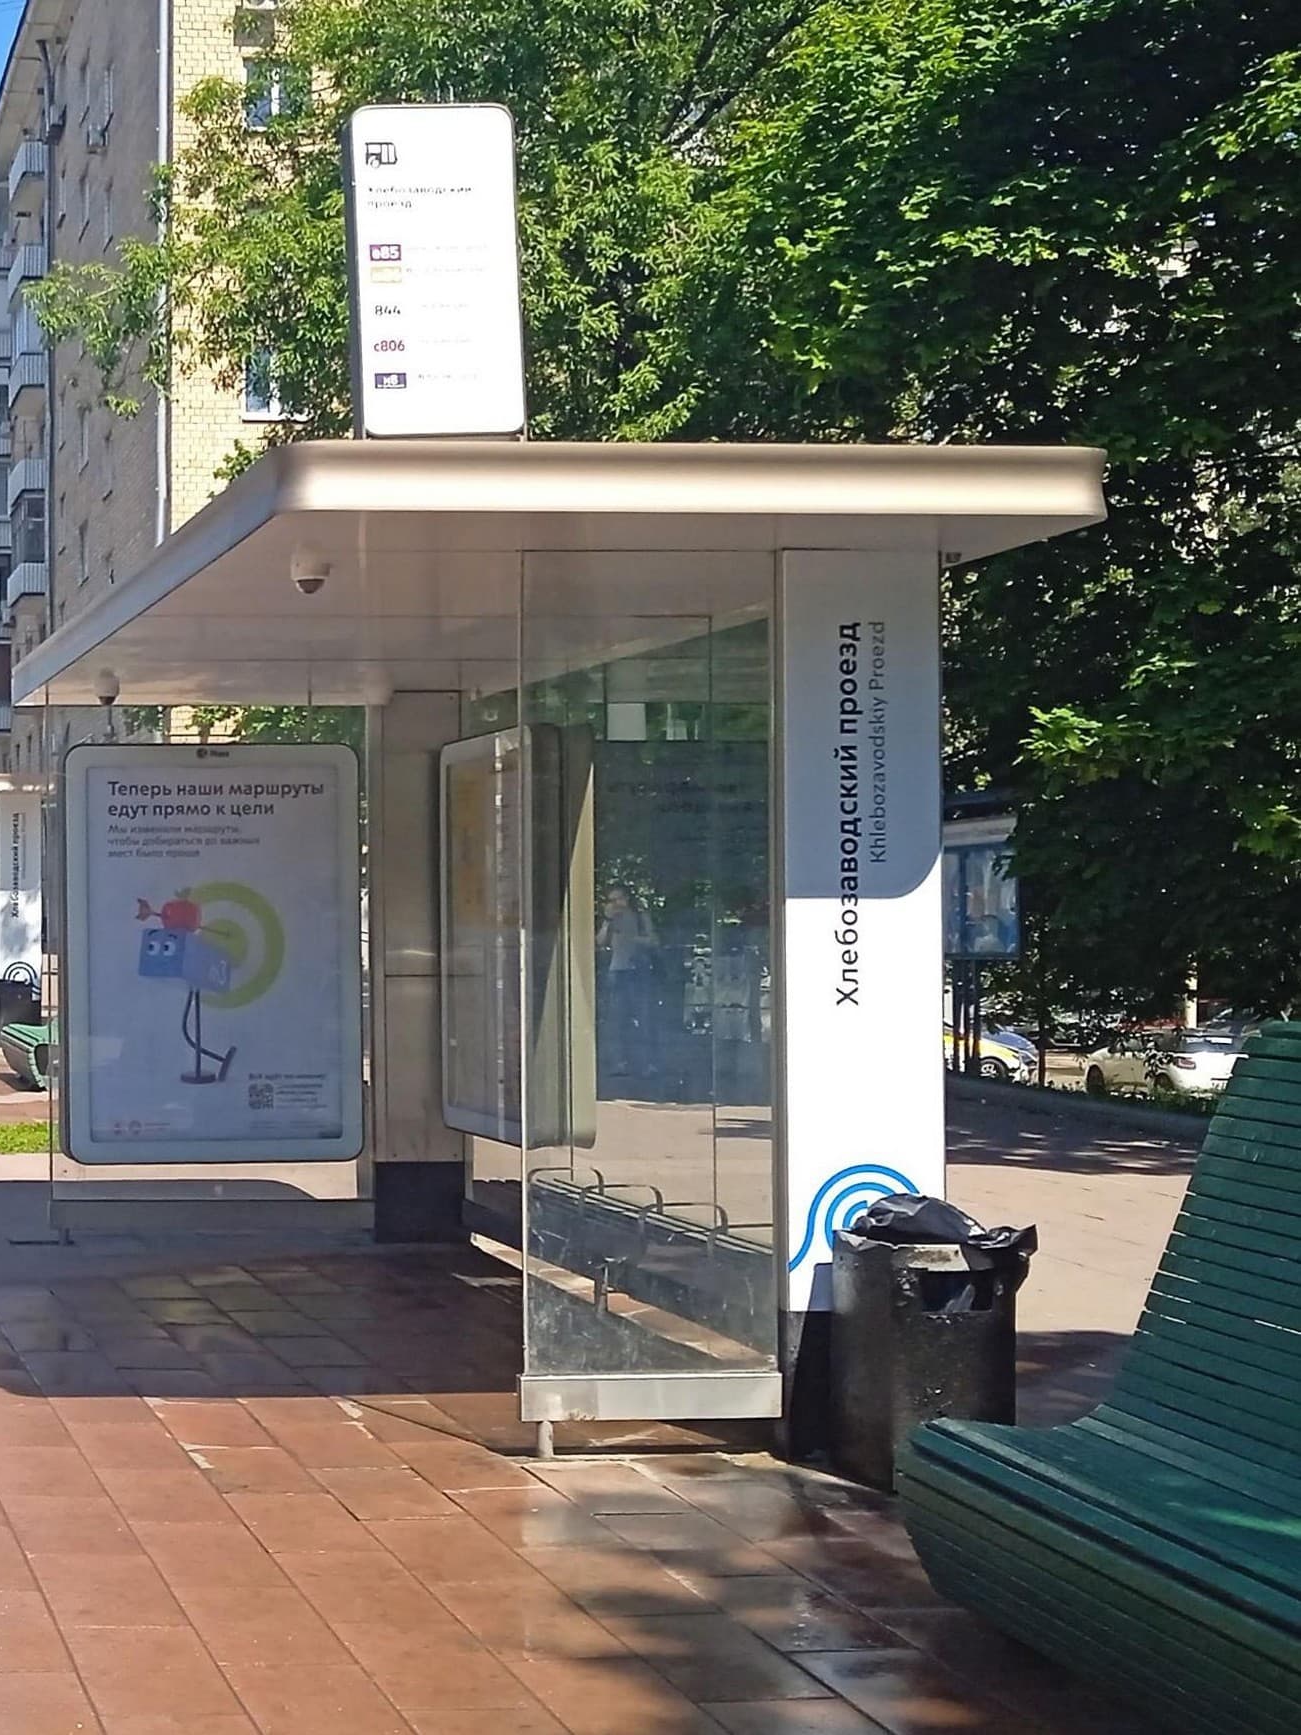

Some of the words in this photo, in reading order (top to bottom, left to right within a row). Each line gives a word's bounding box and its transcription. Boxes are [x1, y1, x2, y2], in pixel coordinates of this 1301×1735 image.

[840, 622, 863, 734] проезд
[869, 621, 886, 690] Proezd
[107, 805, 149, 819] едут
[153, 804, 211, 819] прямо
[216, 805, 226, 815] к
[231, 803, 274, 817] цели
[108, 781, 172, 799] Теперь
[176, 784, 224, 796] наши
[228, 783, 324, 799] маршруты
[869, 697, 888, 863] Khlebozavodskiy
[834, 748, 862, 1006] Хлебозаводский
